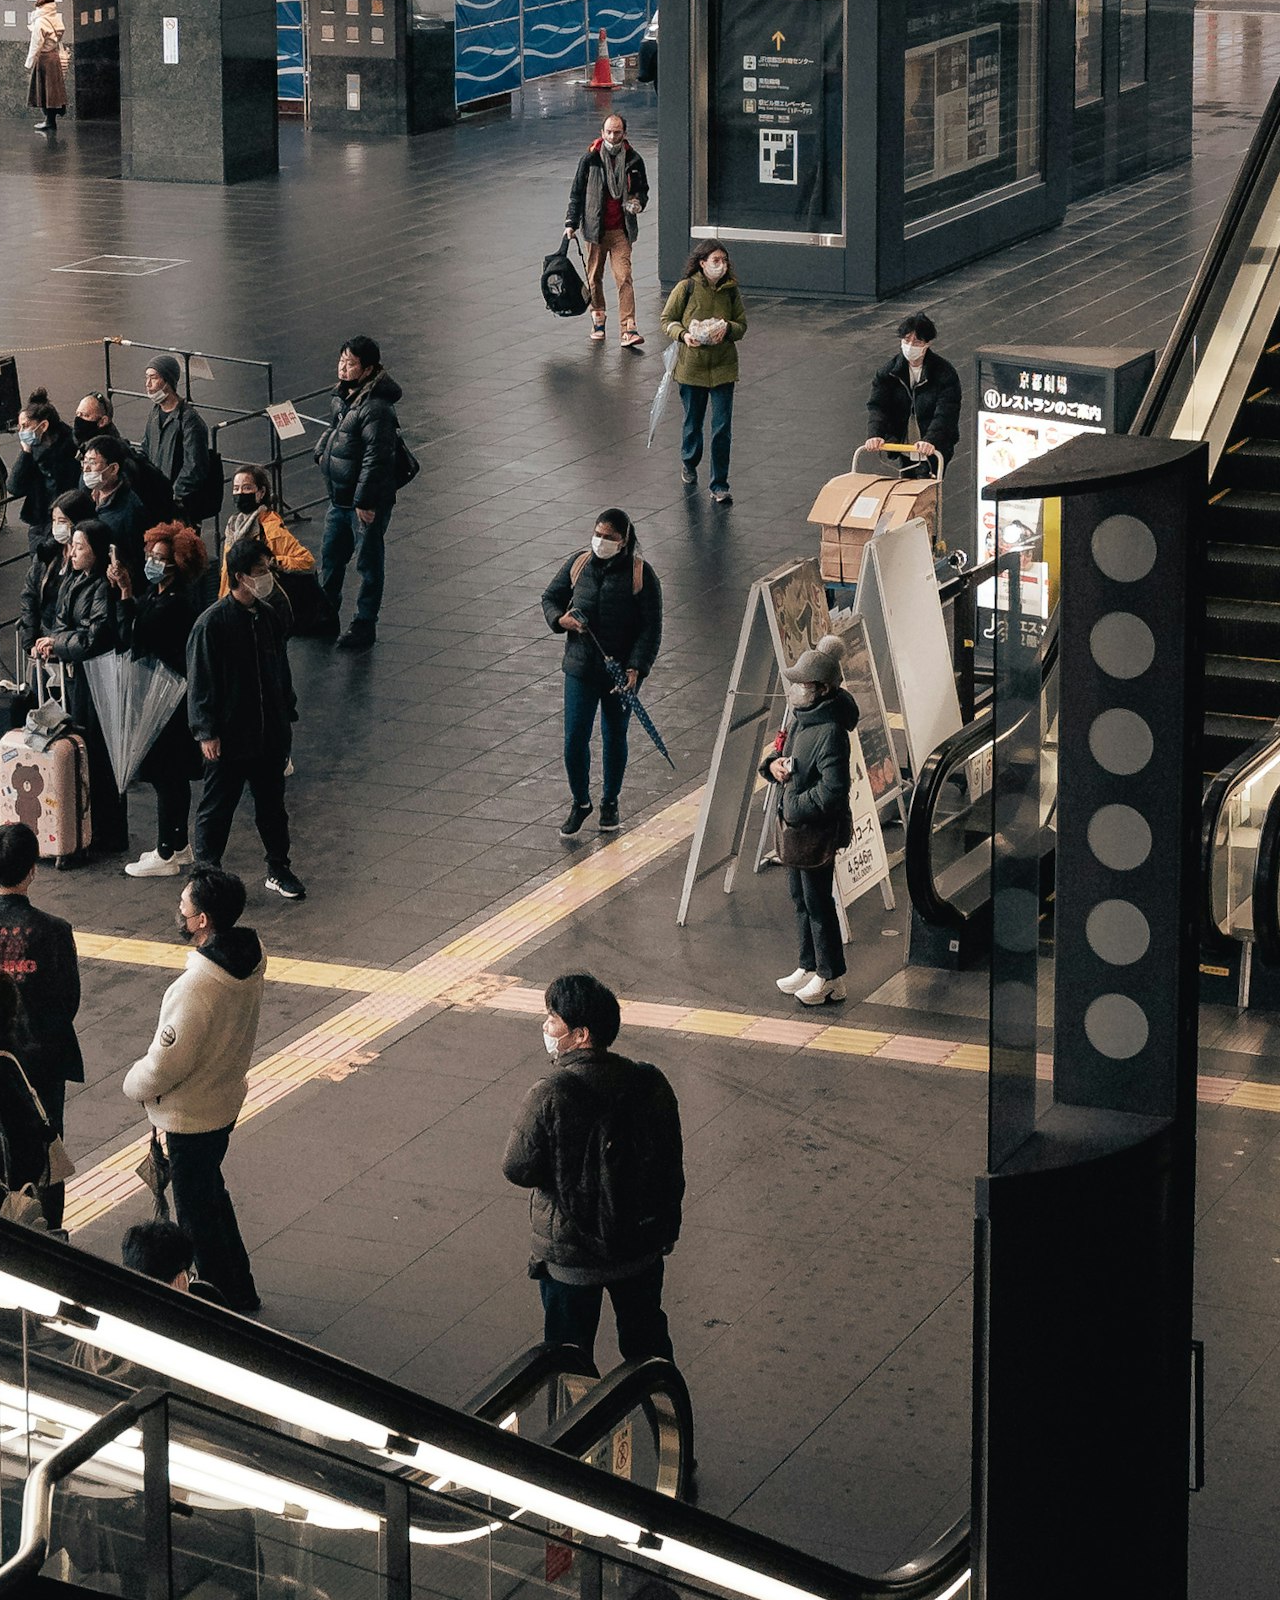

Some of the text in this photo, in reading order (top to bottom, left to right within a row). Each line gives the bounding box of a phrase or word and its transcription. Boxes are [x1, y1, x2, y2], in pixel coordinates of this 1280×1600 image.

[1019, 371, 1068, 395] 京都劇場
[1001, 393, 1102, 422] レストランのご案内
